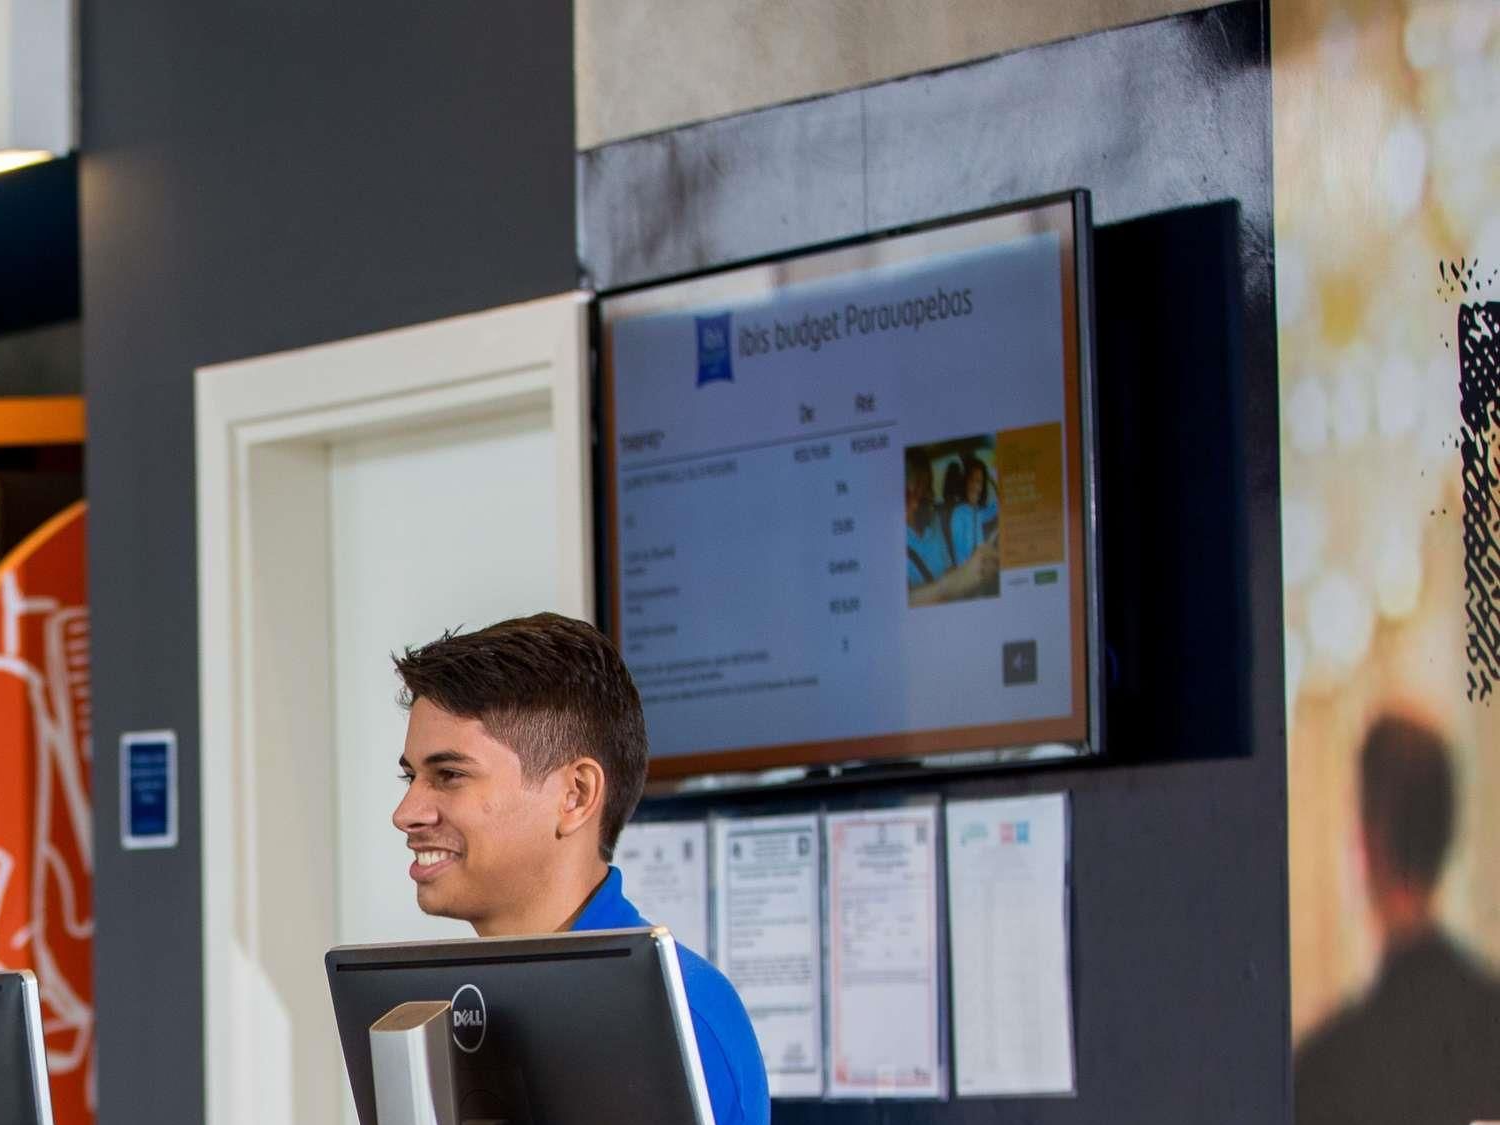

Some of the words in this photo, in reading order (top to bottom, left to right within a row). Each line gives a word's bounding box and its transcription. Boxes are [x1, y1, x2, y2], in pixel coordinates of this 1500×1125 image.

[774, 310, 841, 352] budget
[845, 286, 973, 336] Parauapebas
[452, 1008, 483, 1027] DELL
